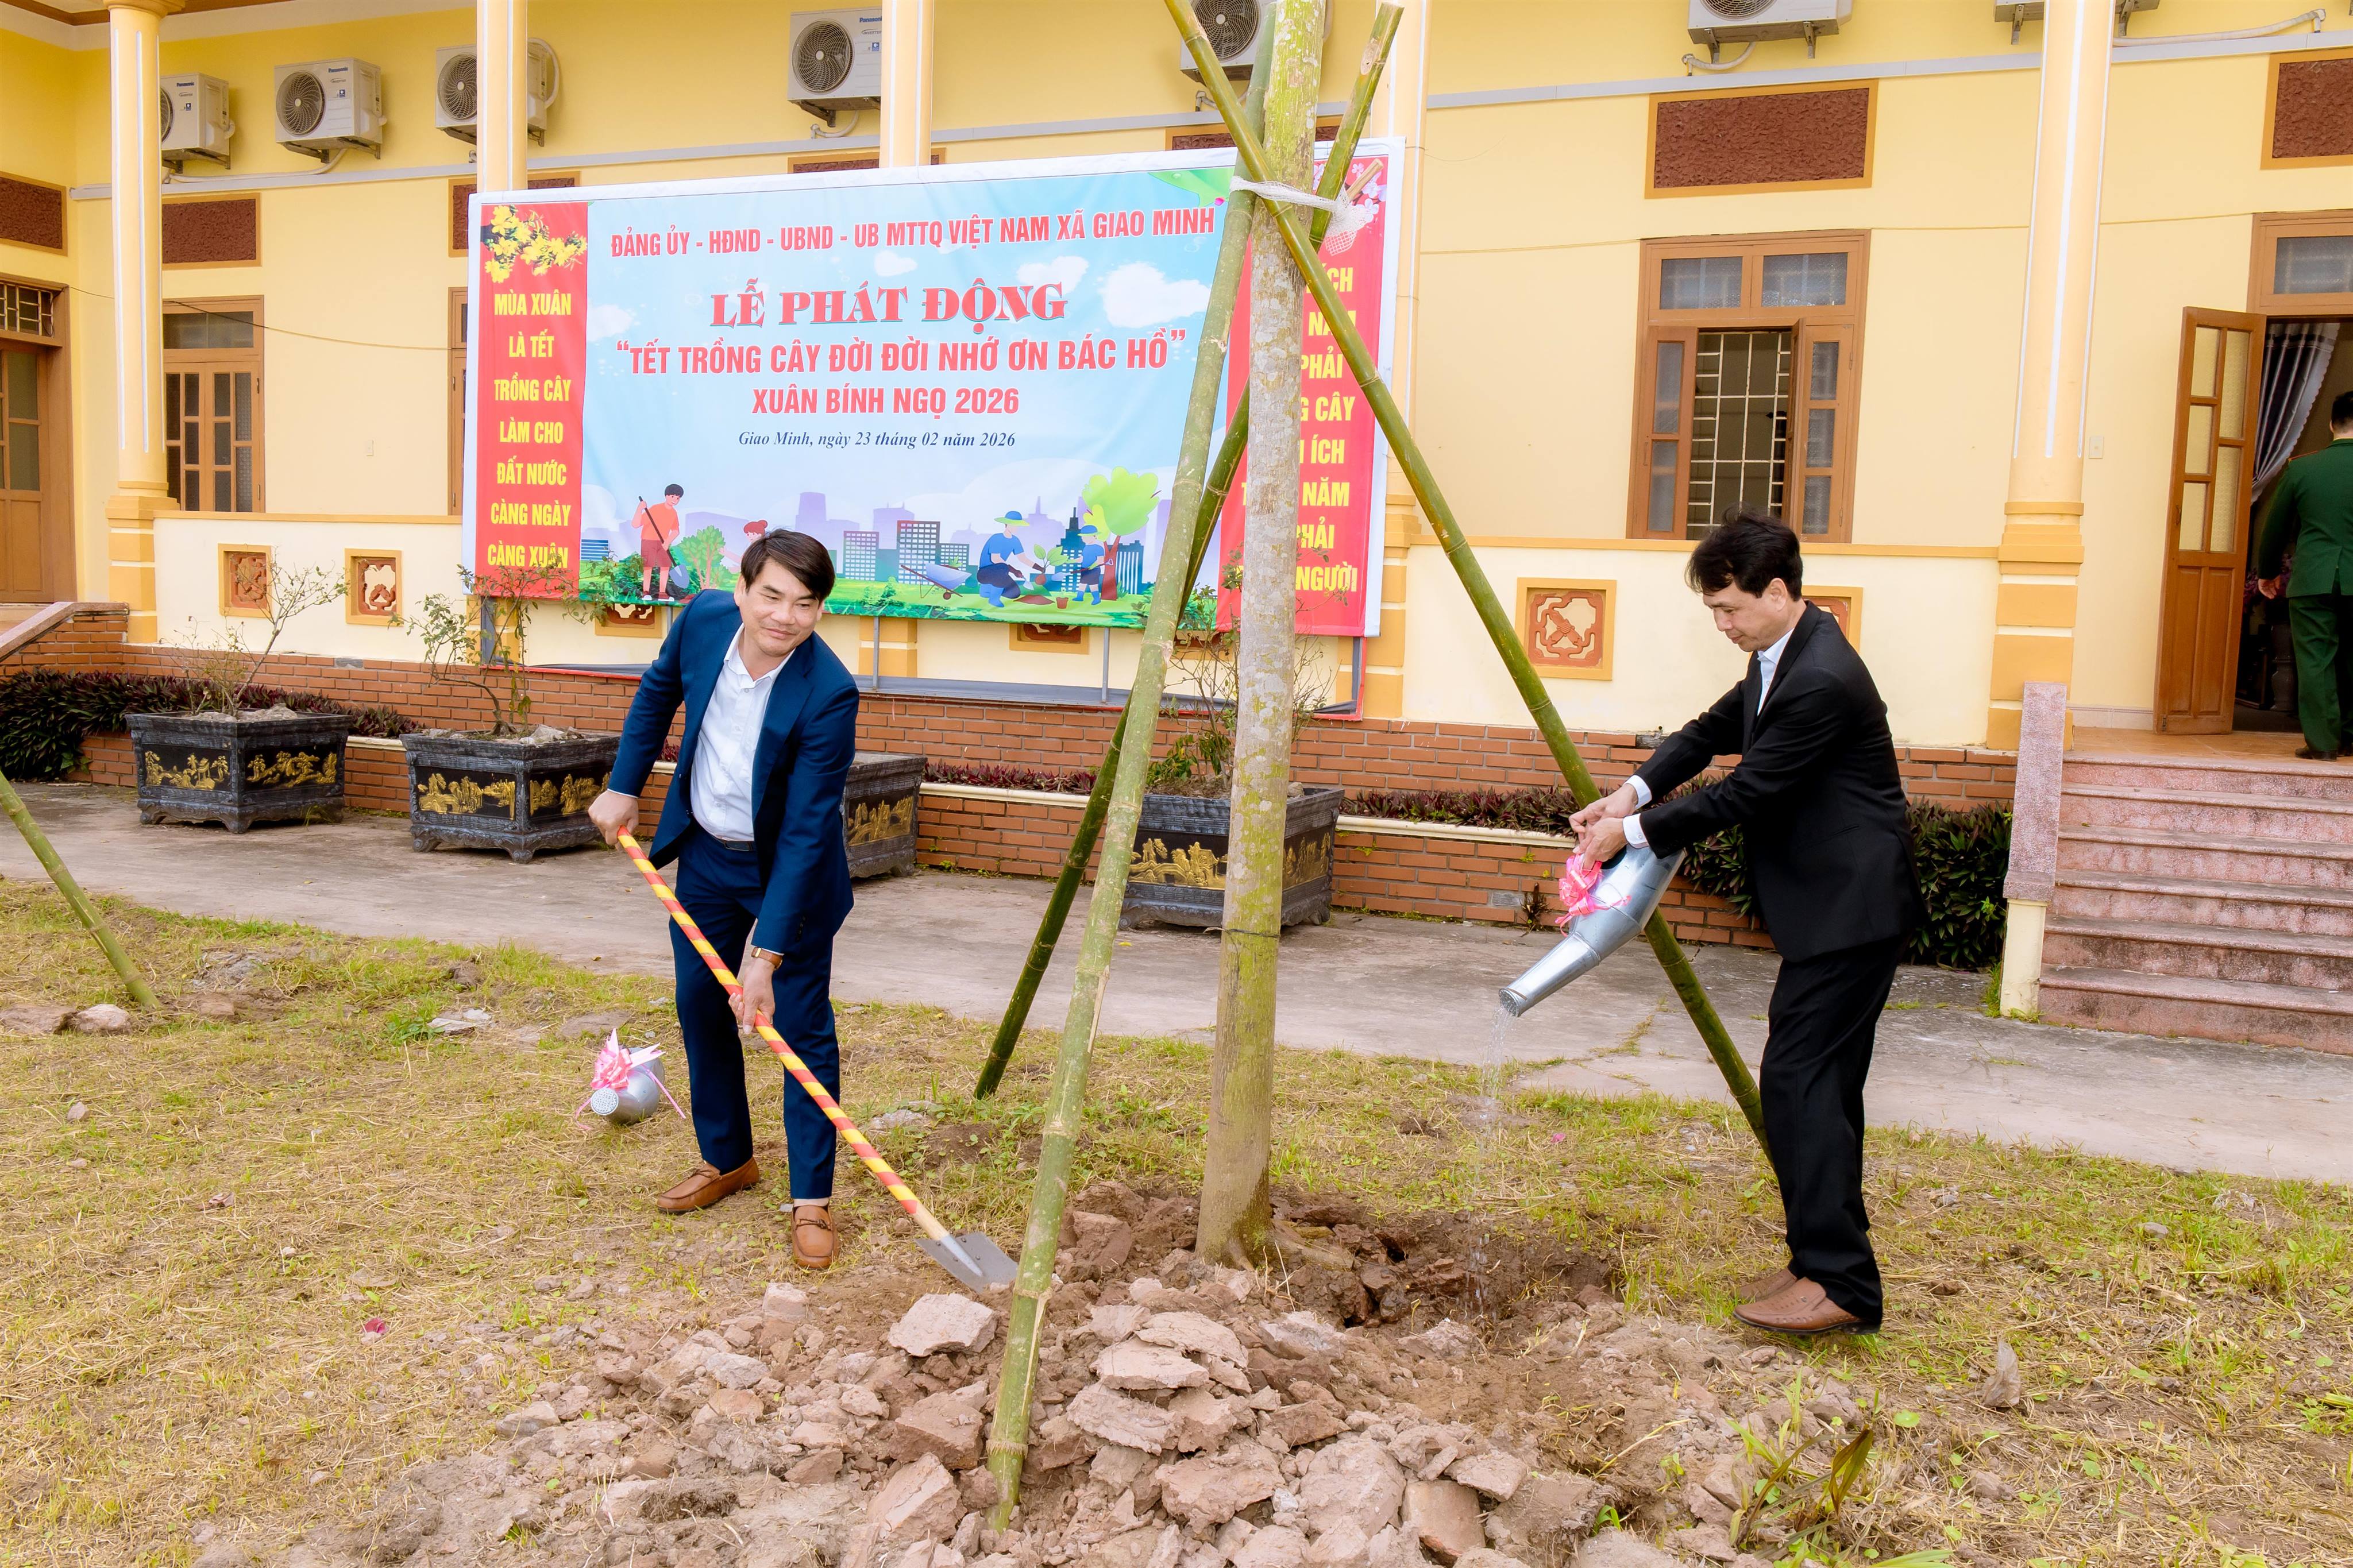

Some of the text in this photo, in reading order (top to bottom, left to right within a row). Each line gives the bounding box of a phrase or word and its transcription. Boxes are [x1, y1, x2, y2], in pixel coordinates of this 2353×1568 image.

[611, 226, 661, 257] ĐẢNG
[666, 224, 690, 255] ỦY
[709, 228, 761, 253] HĐND
[780, 225, 833, 250] UBND
[854, 223, 879, 248] UB
[886, 220, 943, 248] MTTQ
[948, 214, 993, 249] VIỆT
[1000, 215, 1049, 242] NAM
[1056, 208, 1085, 240] XÃ
[1093, 210, 1144, 238] GIAO
[1152, 207, 1214, 235] MINH
[495, 289, 571, 315] MÙA XUÂN
[710, 277, 1069, 334] LỄ PHÁT ĐỘNG
[509, 329, 554, 357] LÀ TẾT
[678, 337, 761, 373] TRỒNG
[770, 339, 821, 373] CÂY
[828, 337, 872, 372] ĐỜI
[881, 335, 928, 371] ĐỜI
[938, 336, 1000, 370] NHỚ
[1008, 338, 1048, 370] ƠN
[1058, 333, 1116, 369] BÁC
[543, 375, 571, 401] CÂY
[751, 383, 1019, 419] XUÂN BÍNH NGỌ 2026
[1315, 391, 1356, 421] CÂY
[500, 417, 564, 444] LÀM CHO
[739, 431, 1015, 450] Giao Minh, ngày 23 tháng 02 năm 2026
[1311, 434, 1345, 464] ÍCH
[496, 455, 567, 485] ĐẤT NƯỚC
[1302, 477, 1350, 507] NĂM
[491, 498, 571, 526] CÀNG NGÀY
[488, 540, 568, 569] CÀNG XUÂN
[1295, 561, 1358, 592] NGƯỜI
